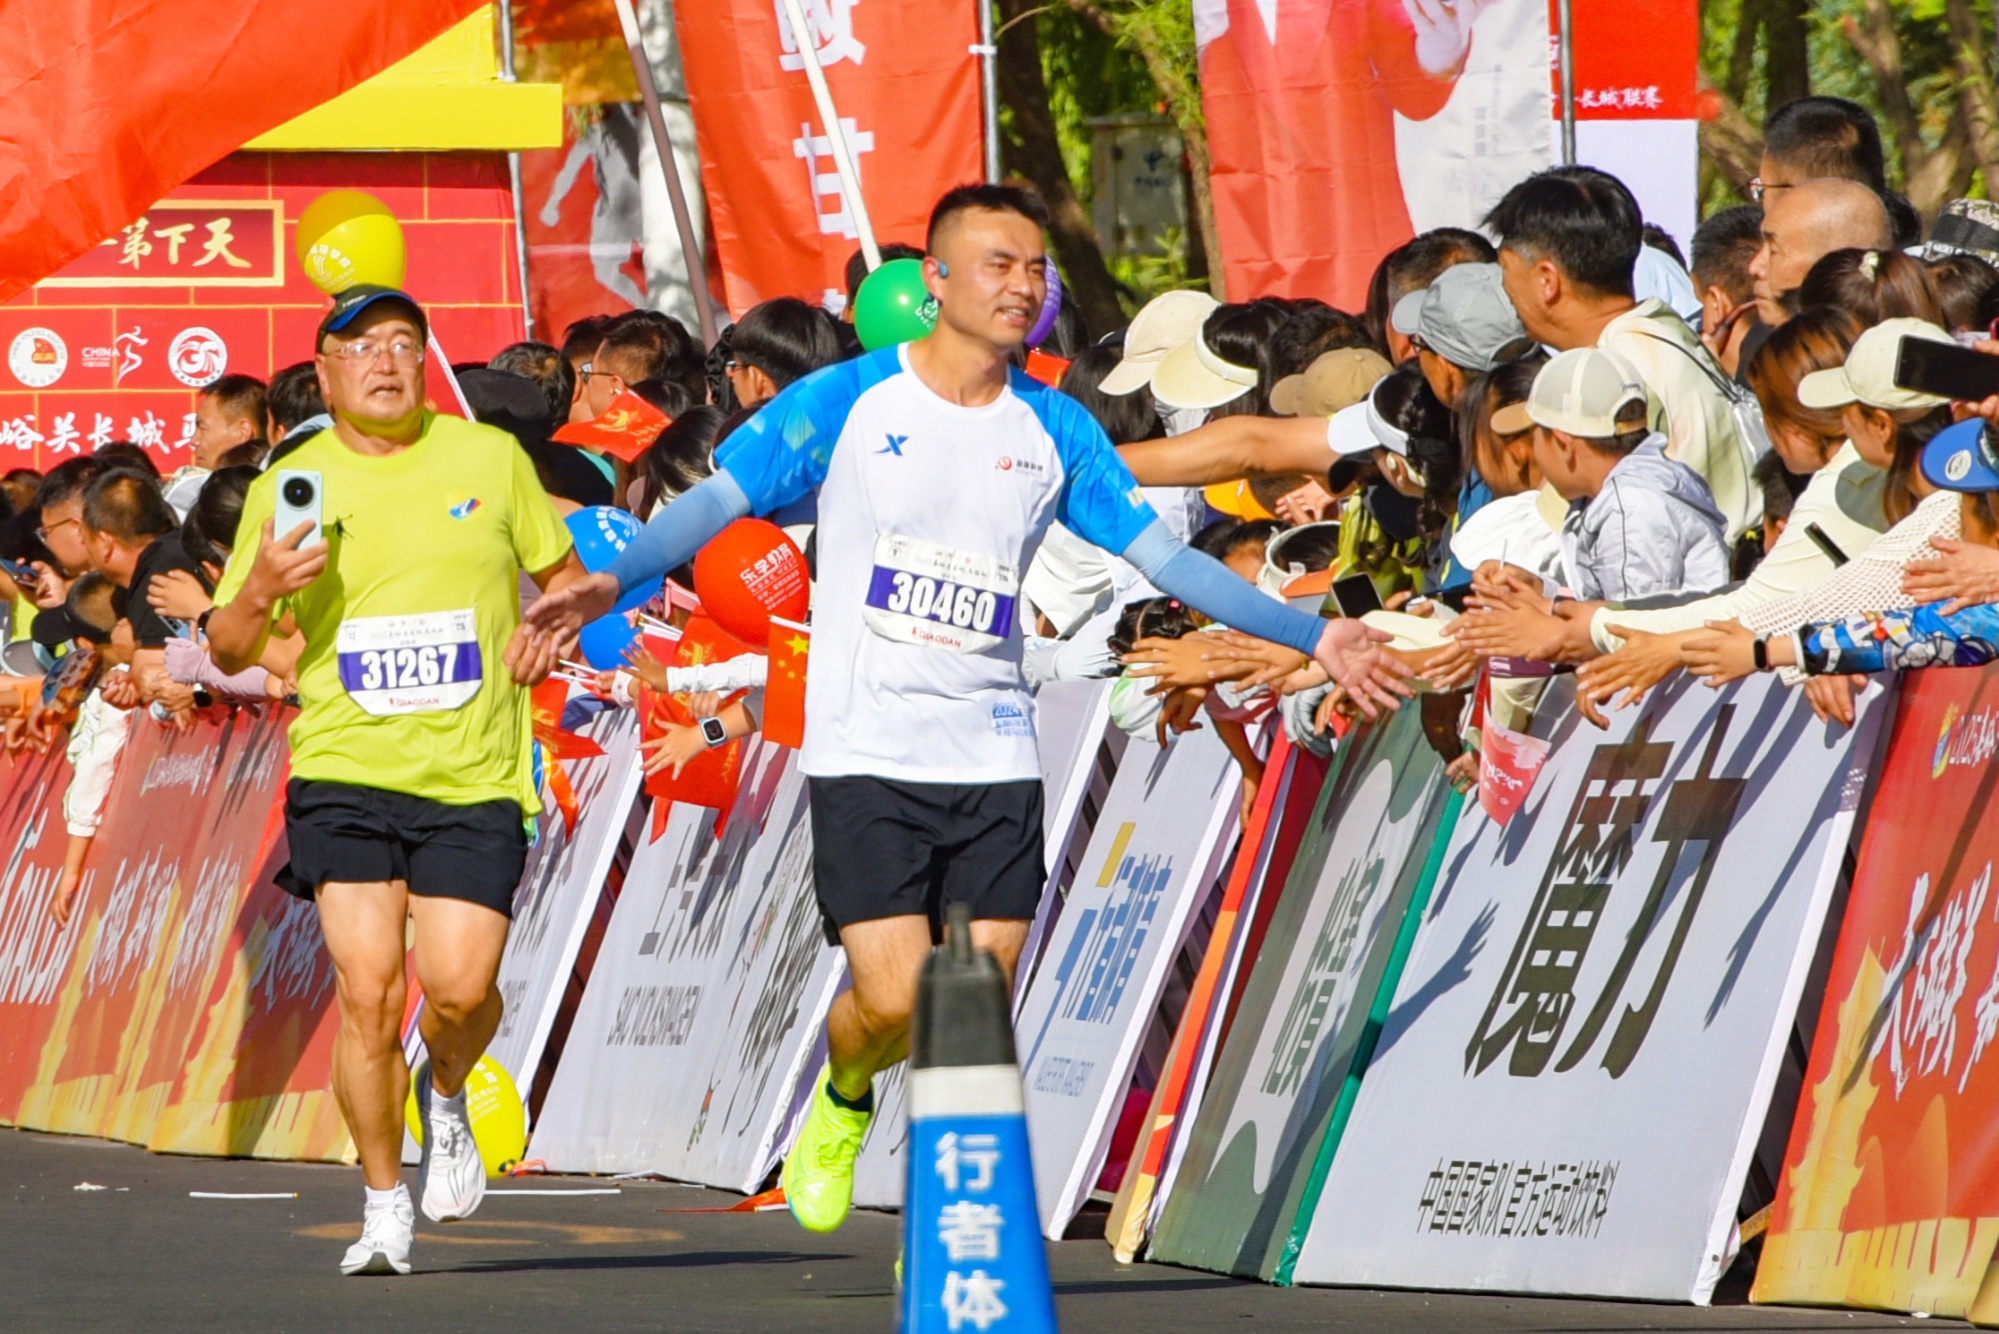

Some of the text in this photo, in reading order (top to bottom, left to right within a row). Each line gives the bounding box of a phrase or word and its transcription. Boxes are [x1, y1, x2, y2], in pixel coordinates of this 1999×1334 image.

[81, 347, 120, 358] CHINA
[888, 571, 997, 633] 30460
[361, 644, 458, 690] 31267
[1464, 704, 1748, 1079] 魔力
[934, 1130, 1009, 1331] 行者体
[1417, 1156, 1621, 1240] 中国国家队官方运动饮料
